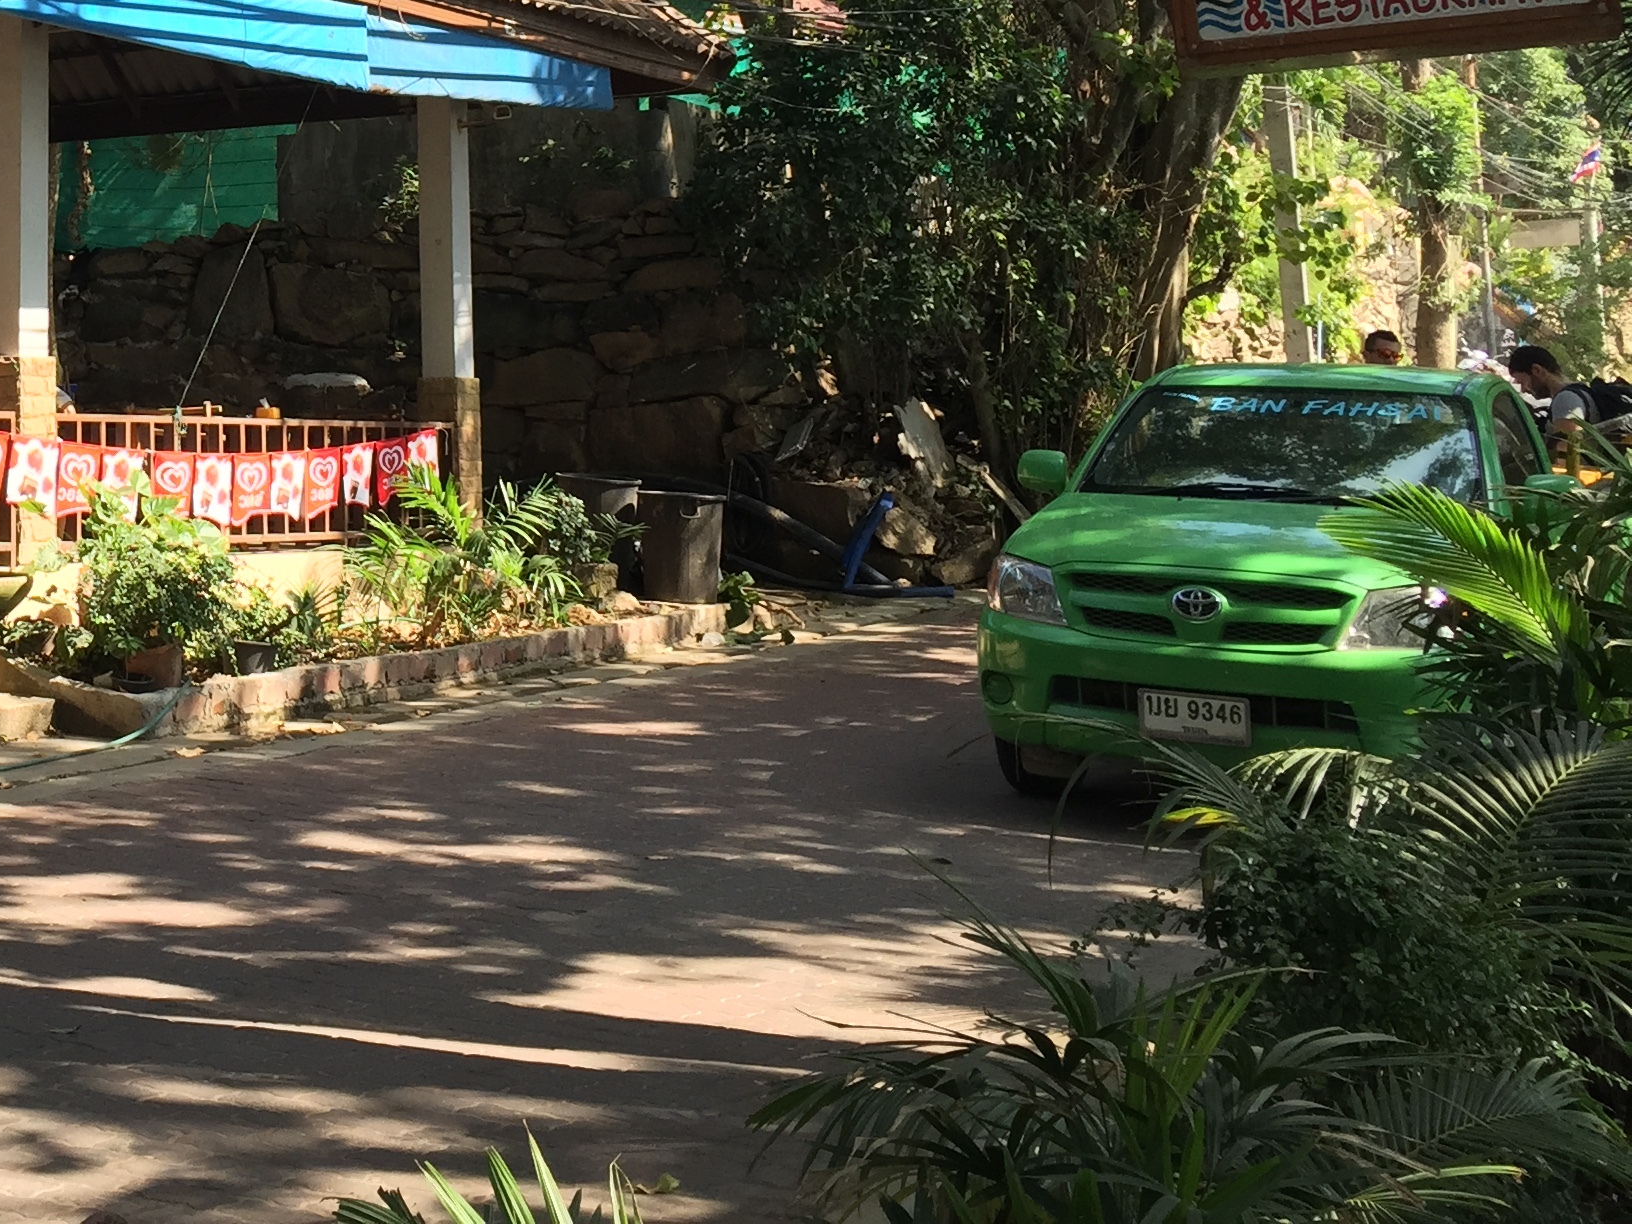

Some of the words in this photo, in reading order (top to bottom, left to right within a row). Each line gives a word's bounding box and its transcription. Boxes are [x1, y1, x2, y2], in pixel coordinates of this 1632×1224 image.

[1209, 396, 1288, 414] BAN
[1300, 398, 1442, 421] FAHSAI
[1186, 699, 1243, 726] 9346
